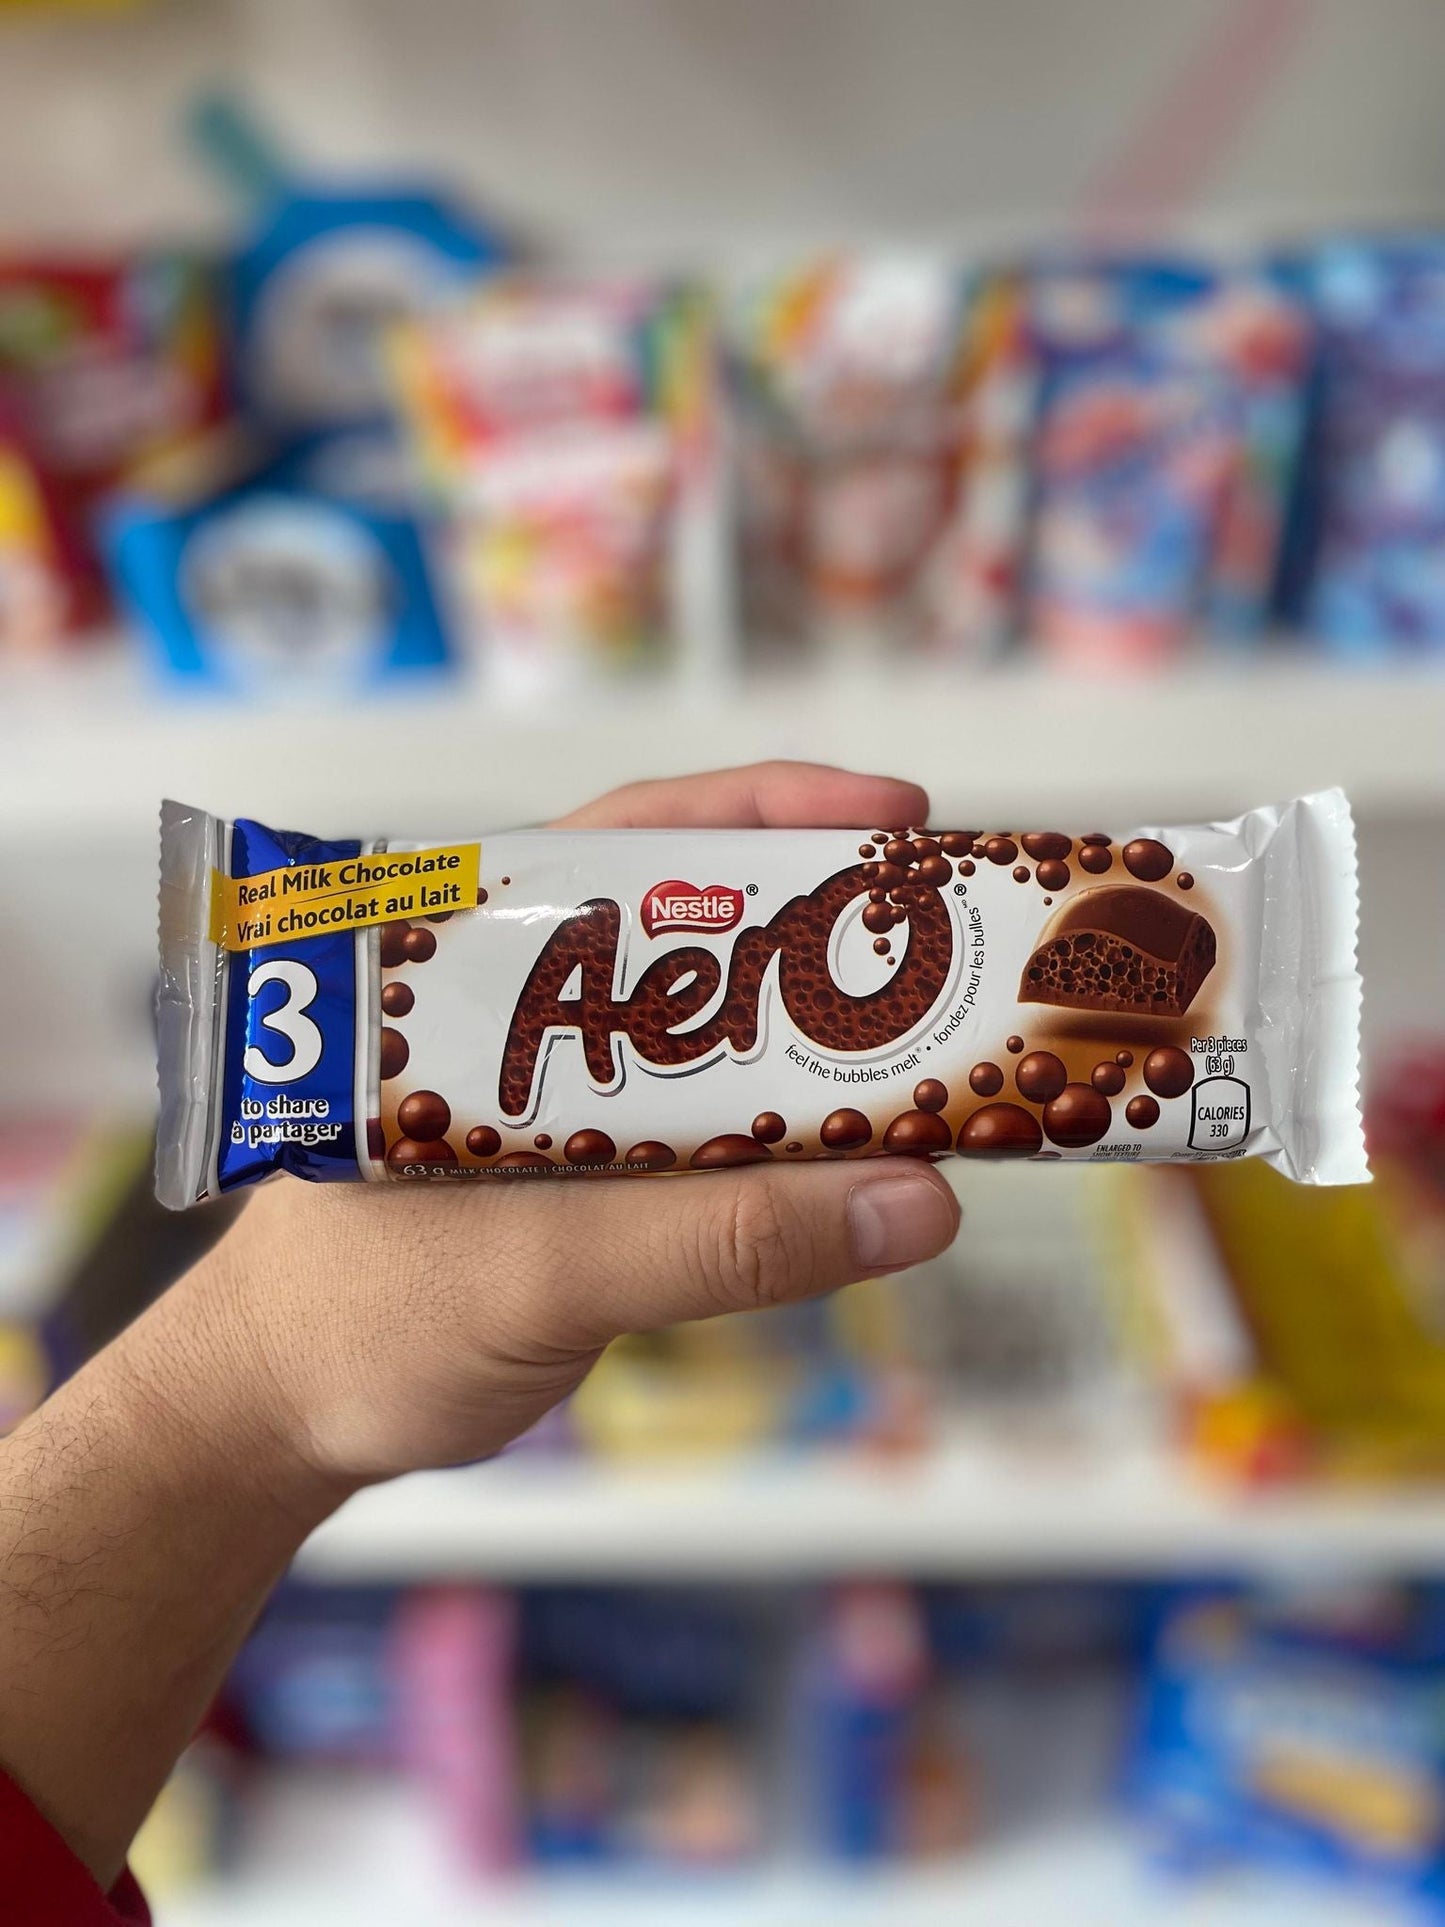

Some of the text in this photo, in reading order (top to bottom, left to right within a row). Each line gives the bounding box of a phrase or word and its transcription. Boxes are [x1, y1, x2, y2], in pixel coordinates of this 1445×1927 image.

[238, 854, 461, 906] Real Milk Chocolate
[237, 884, 461, 943] Vrai chocolat au lait
[499, 861, 953, 1116] Aero
[933, 906, 985, 1045] fondez pour les bulles
[243, 961, 322, 1083] 3
[1191, 1036, 1247, 1056] Per 3 pieces
[784, 1044, 921, 1083] feel the bubbles melt
[1206, 1056, 1223, 1074] (63
[242, 1094, 329, 1118] to share
[1197, 1106, 1245, 1121] CALORIES
[232, 1121, 342, 1147] à partager
[1209, 1124, 1229, 1137] 330
[403, 1164, 427, 1176] 63
[432, 1166, 445, 1177] g
[480, 1166, 539, 1175] CHOCOLATE
[552, 1164, 605, 1174] CHOCOLAT
[607, 1163, 624, 1171] AU
[627, 1162, 650, 1171] LAIT
